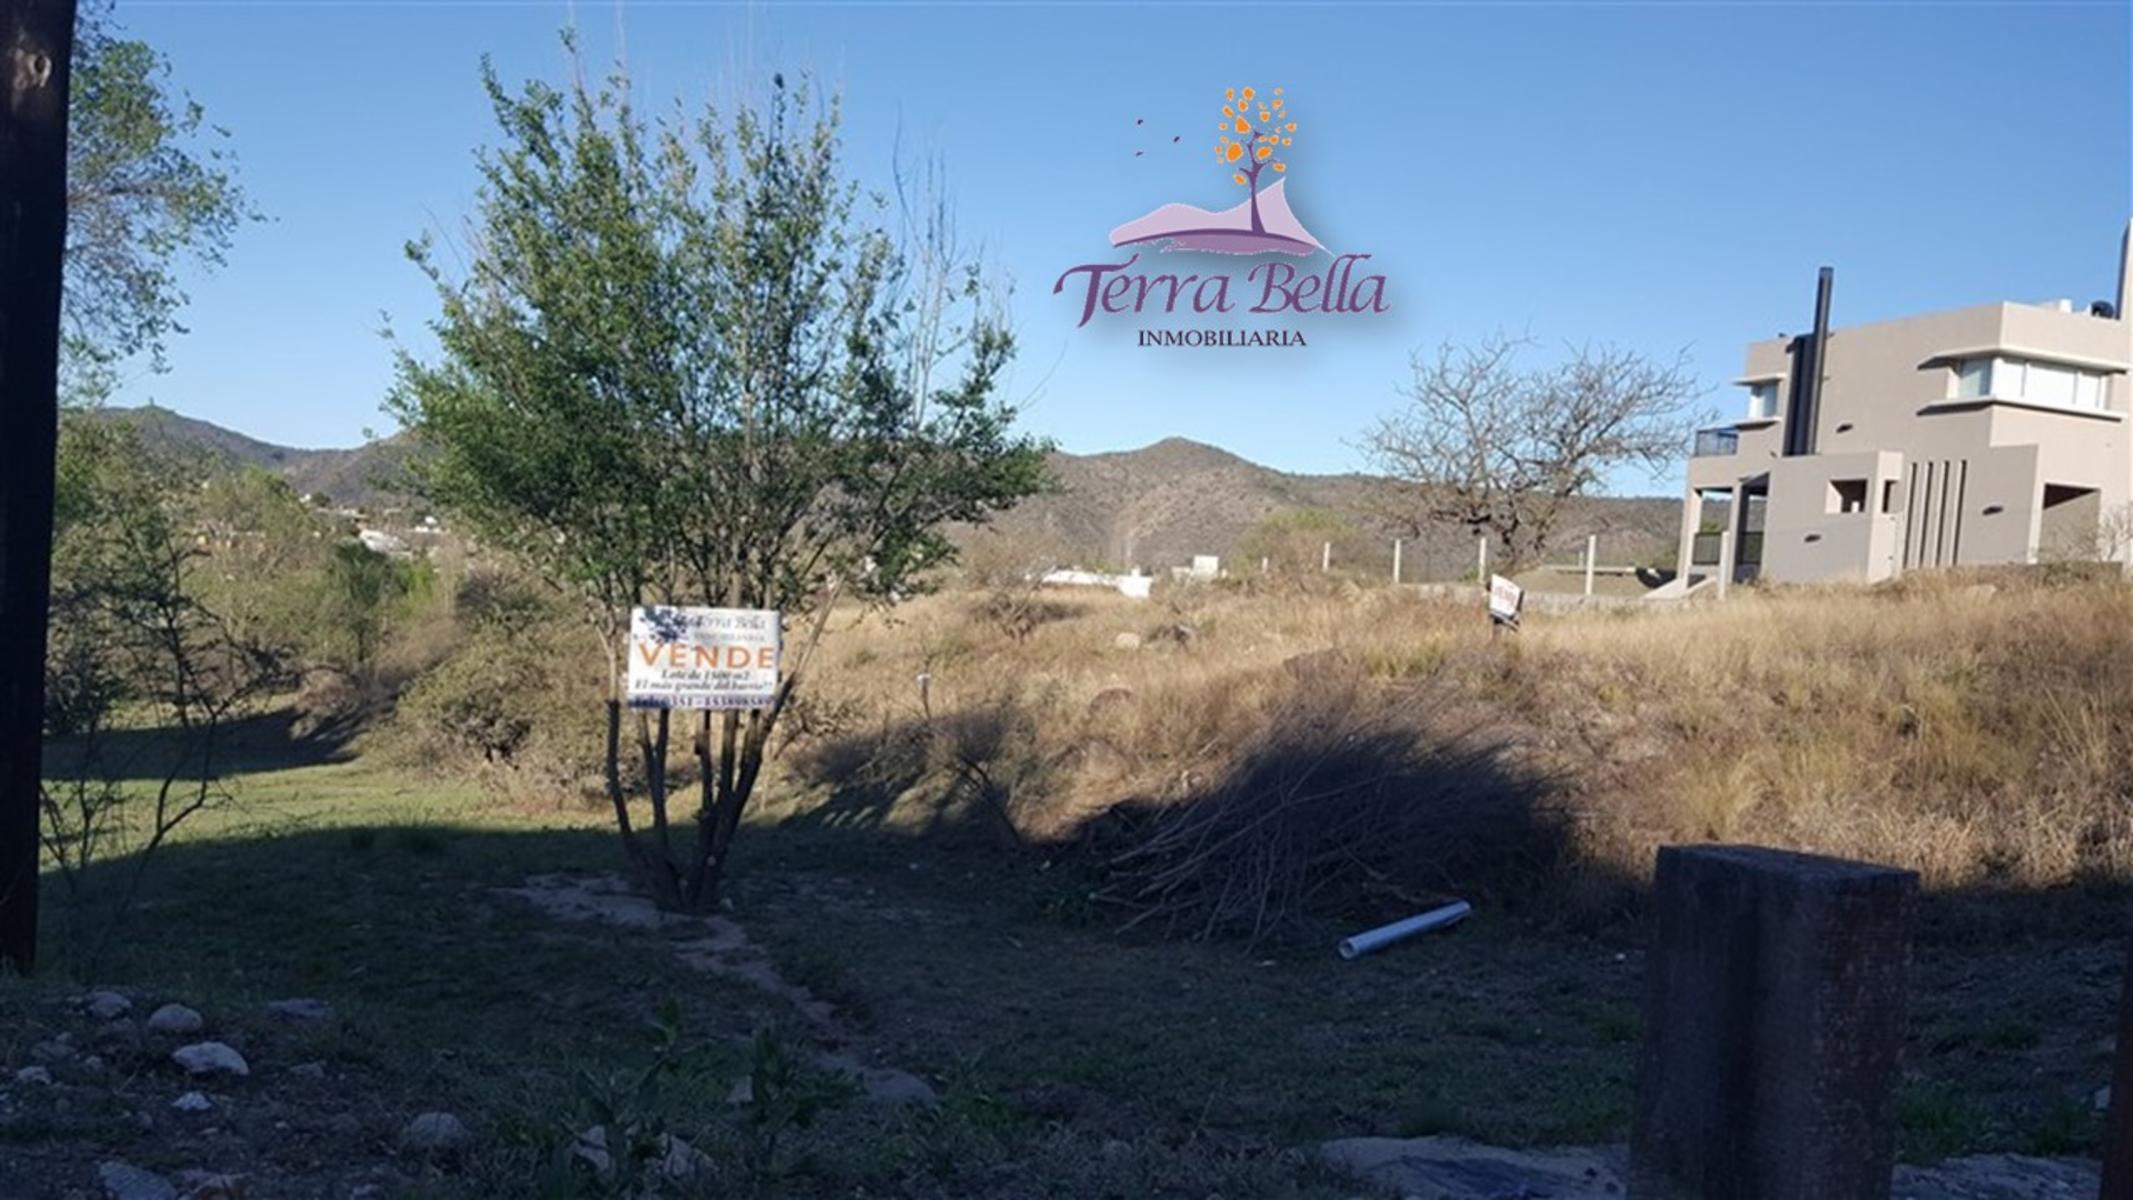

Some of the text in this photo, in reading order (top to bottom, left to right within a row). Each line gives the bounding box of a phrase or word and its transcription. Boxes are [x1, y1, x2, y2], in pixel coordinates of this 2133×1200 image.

[639, 643, 773, 669] VENDE
[662, 670, 685, 680] Lote
[687, 670, 700, 679] de
[674, 681, 710, 692] grande
[713, 681, 730, 690] del
